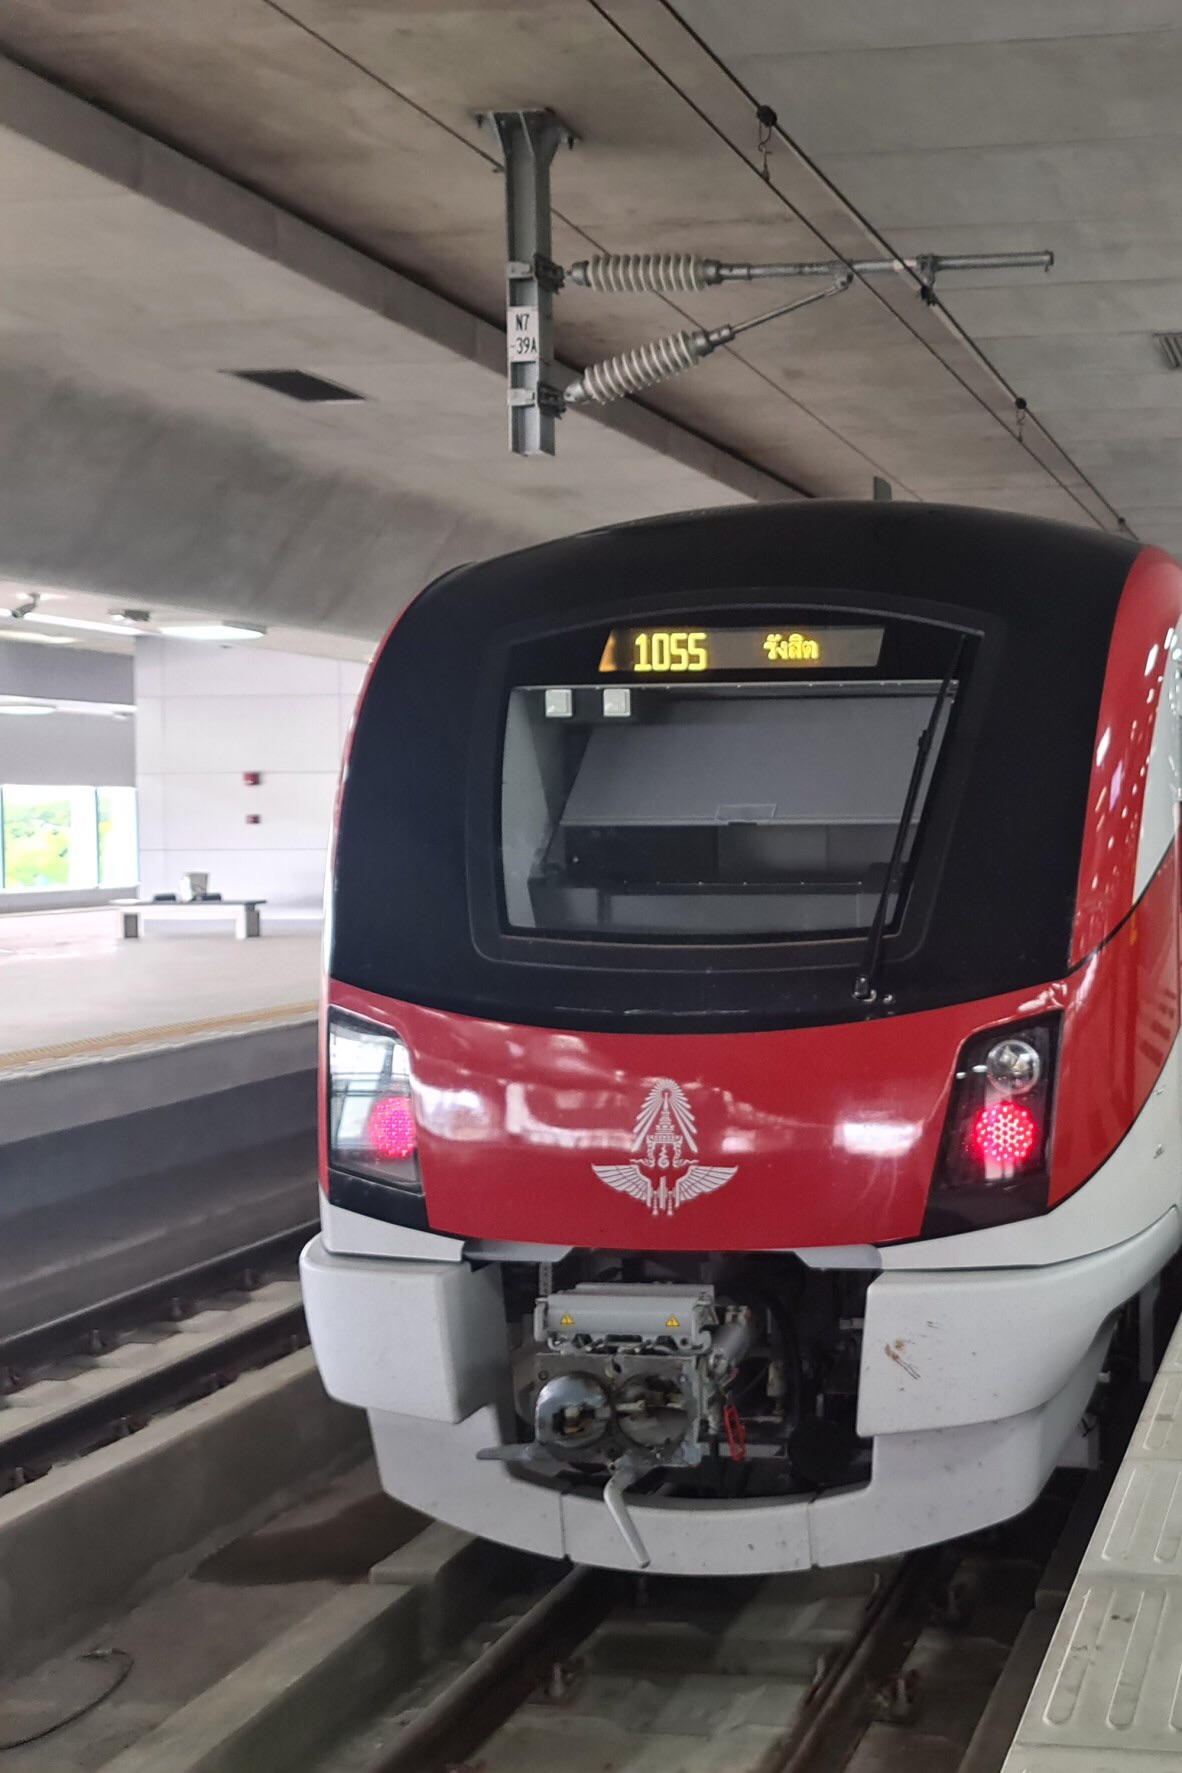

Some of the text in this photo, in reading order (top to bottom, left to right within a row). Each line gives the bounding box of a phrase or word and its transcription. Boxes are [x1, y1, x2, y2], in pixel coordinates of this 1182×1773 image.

[515, 313, 530, 331] N7
[516, 336, 537, 355] 39A
[634, 632, 707, 672] 1055
[762, 633, 819, 660] รังสิต
